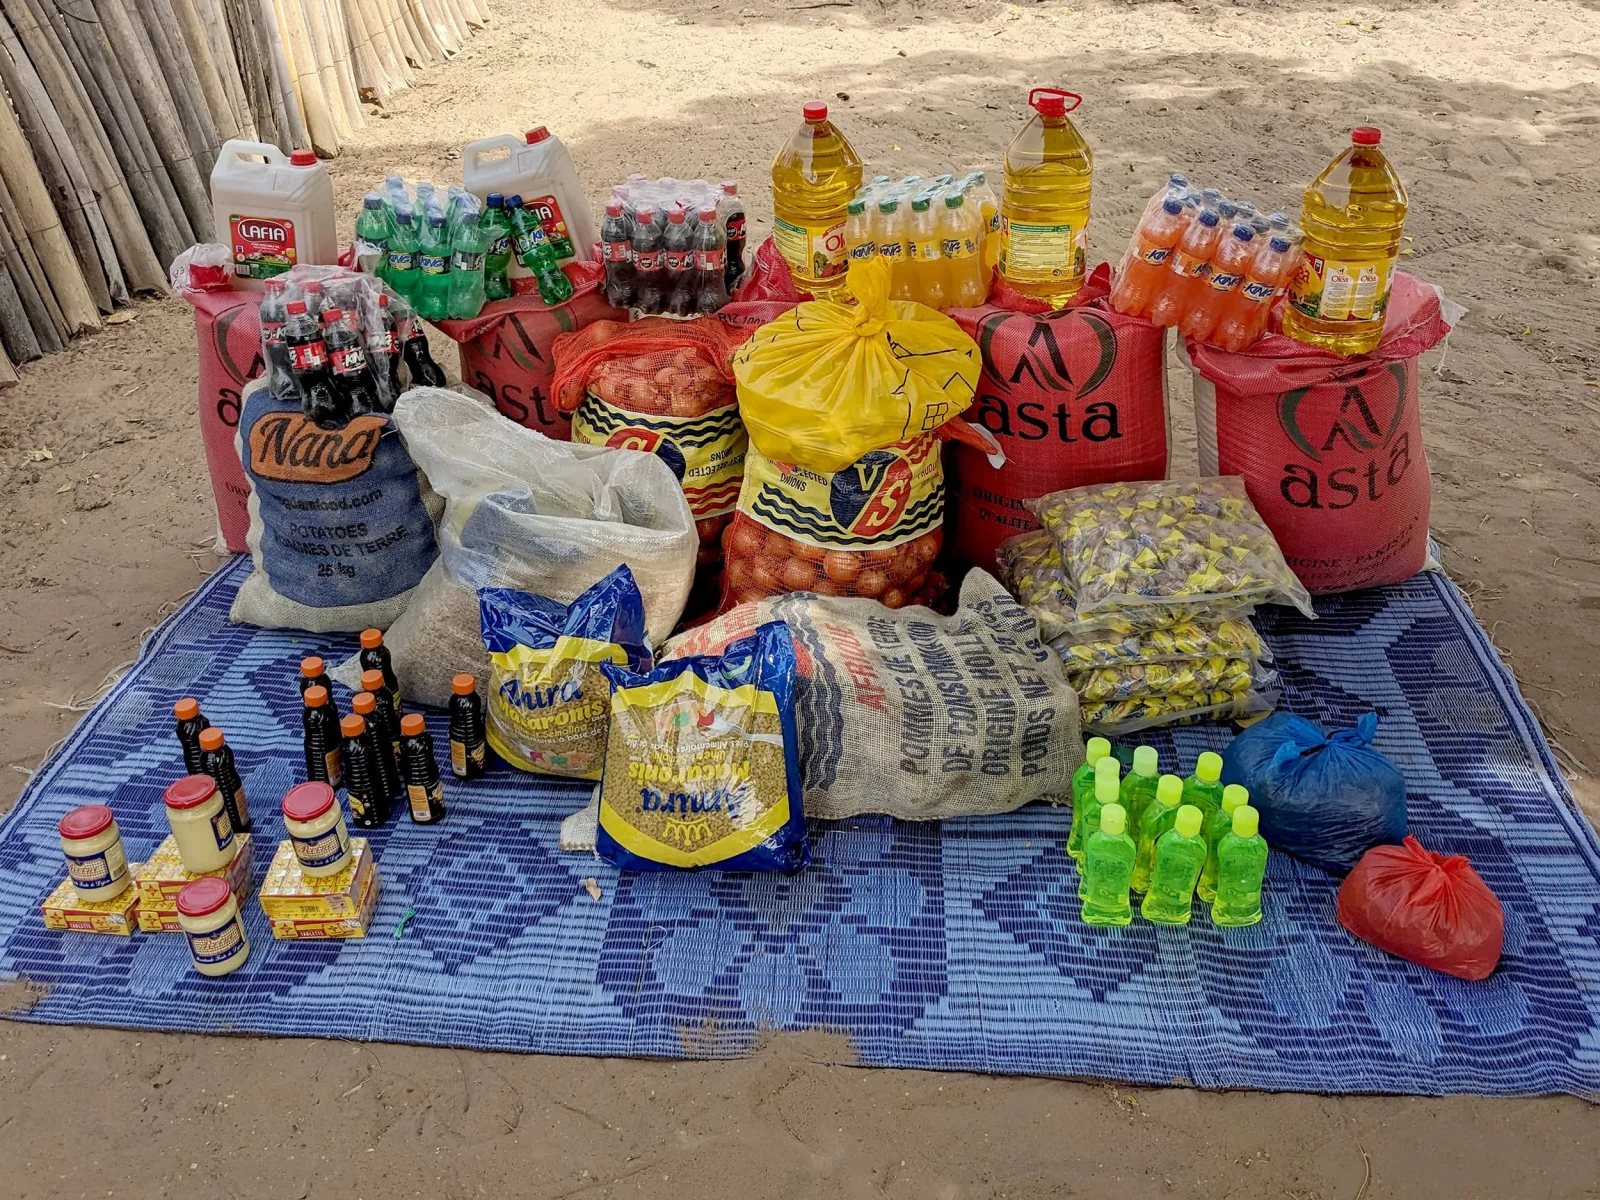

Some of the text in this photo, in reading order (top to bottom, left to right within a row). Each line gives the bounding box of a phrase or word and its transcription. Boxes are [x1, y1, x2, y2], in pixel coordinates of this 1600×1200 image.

[241, 224, 285, 242] LAFIA
[388, 251, 412, 263] KING
[420, 255, 444, 267] KING
[851, 241, 875, 259] KING
[475, 369, 573, 426] ast
[976, 394, 1123, 444] asta
[258, 416, 377, 470] Nana
[1279, 432, 1412, 511] asta
[972, 485, 1026, 512] ORIGIN
[288, 521, 369, 540] POTATOES
[330, 543, 355, 558] DE
[355, 524, 409, 556] TERRE
[316, 562, 335, 578] 25
[989, 633, 1028, 656] 25
[825, 622, 888, 714] AFRIQUE
[1008, 661, 1055, 699] NET
[867, 615, 935, 775] POMMES DE TERRE
[542, 722, 588, 739] Semolina
[567, 731, 590, 742] base
[590, 726, 604, 736] de
[976, 687, 1017, 776] ORIGINE
[1021, 707, 1056, 778] POIDS
[941, 745, 975, 773] DE
[628, 760, 751, 786] Macaronis
